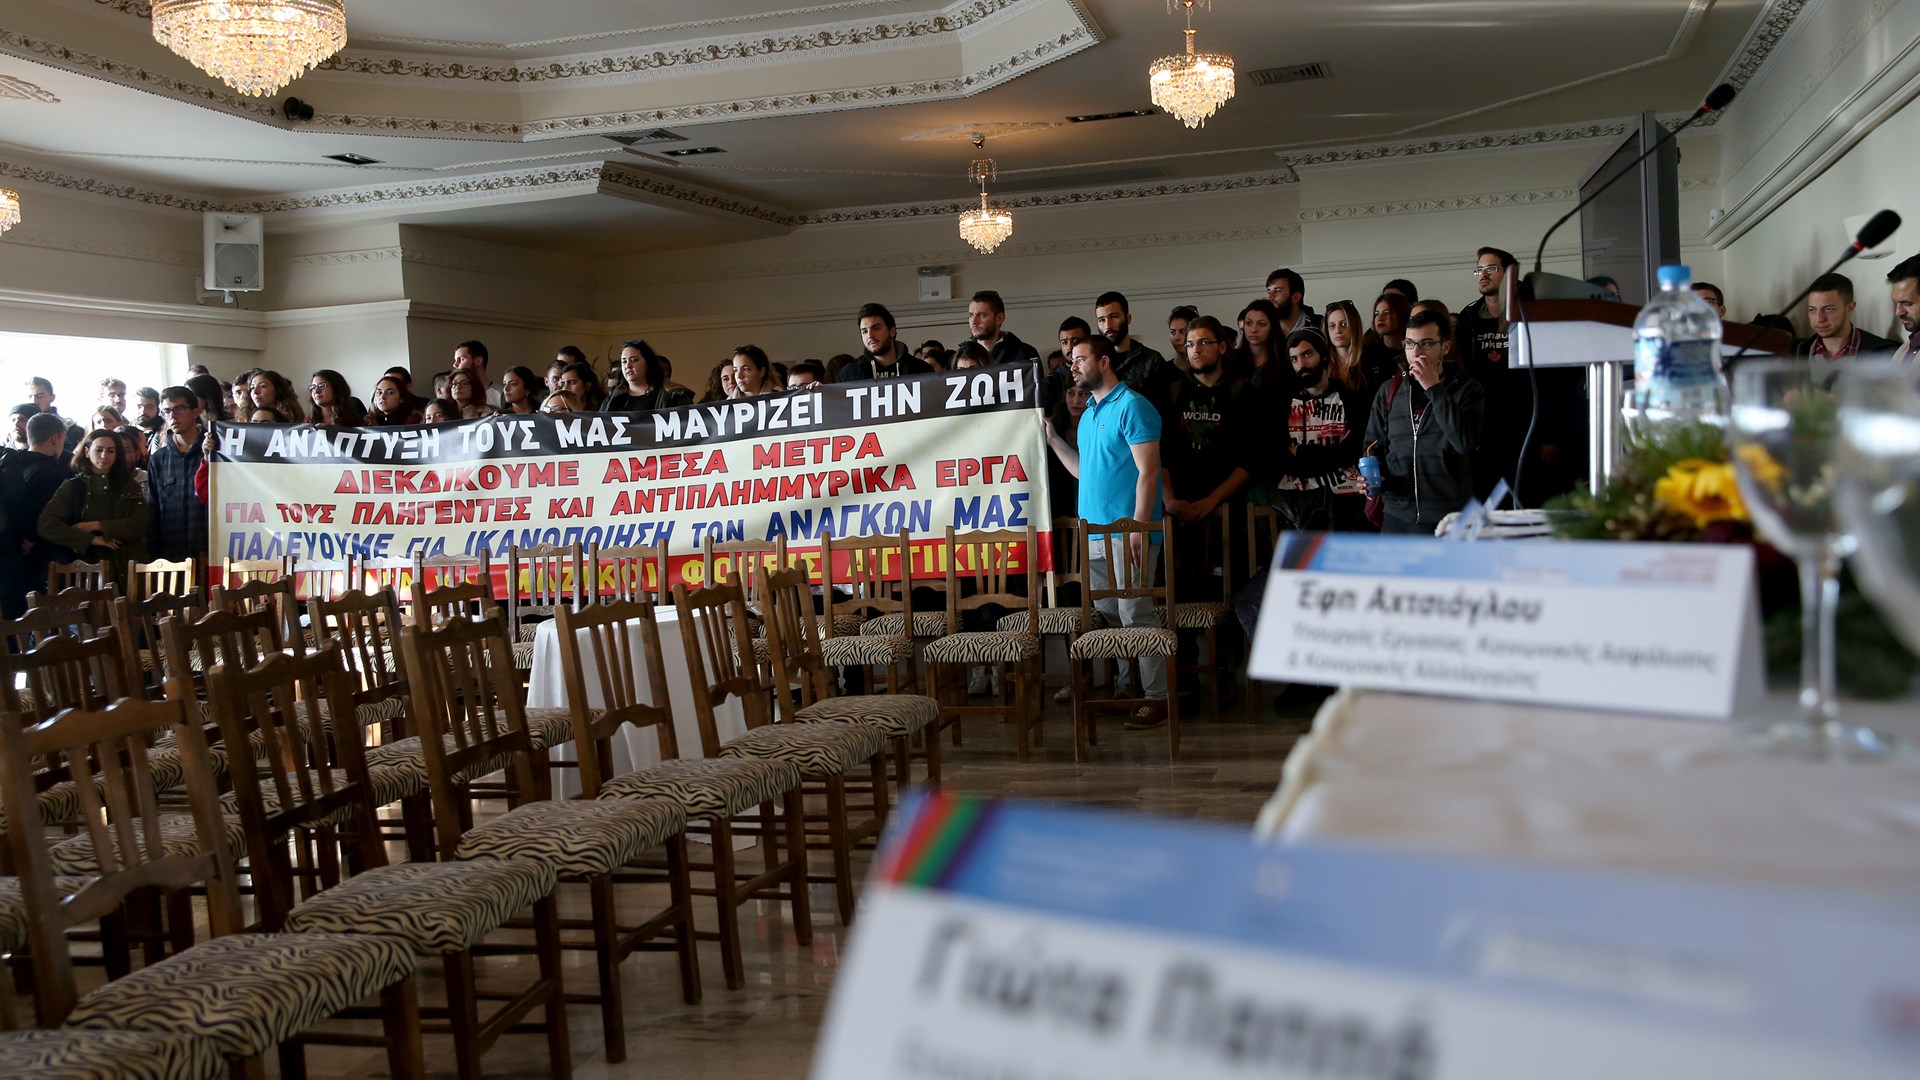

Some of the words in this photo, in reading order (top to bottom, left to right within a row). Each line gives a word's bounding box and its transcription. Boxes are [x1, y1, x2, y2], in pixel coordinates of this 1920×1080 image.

[225, 428, 246, 456] Η
[264, 429, 440, 459] ΑΝΑΠΤΥΞΗ
[458, 420, 541, 454] ΤΟΥΣ
[555, 416, 632, 449] ΜΑΣ
[653, 392, 824, 443] ΜΑΥΡΙΖΕΙ
[845, 381, 922, 421] ΤΗΝ
[944, 368, 1026, 410] ΖΩΗ
[1182, 411, 1221, 422] WORLD
[225, 502, 266, 524] ΓΙΑ
[276, 503, 337, 524] ΤΟΥΣ
[350, 496, 533, 525] ΠΛΗΓΕΝΤΕΣ
[547, 496, 595, 519] ΚΑΙ
[611, 464, 917, 516] ΑΝΤΙΠΛΗΜΜΥΡΙΚΑ
[935, 455, 1030, 489] ΕΡΓΑ
[333, 460, 580, 495] ΔΙΕΚΔΙΚΟΥΜΕ
[602, 449, 729, 484] ΑΜΕΣΑ
[752, 432, 885, 471] ΜΕΤΡΑ
[228, 532, 395, 561] ΠΑΛΕΥΟΥΜΕ
[405, 536, 446, 560] ΓΙΑ
[464, 520, 677, 559] ΙΚΑΝΟΠΟΙΗΣΗ
[691, 519, 745, 549] ΤΩΝ
[765, 499, 933, 542] ΑΝΑΓΚΩΝ
[953, 493, 1030, 530] ΜΑΣ
